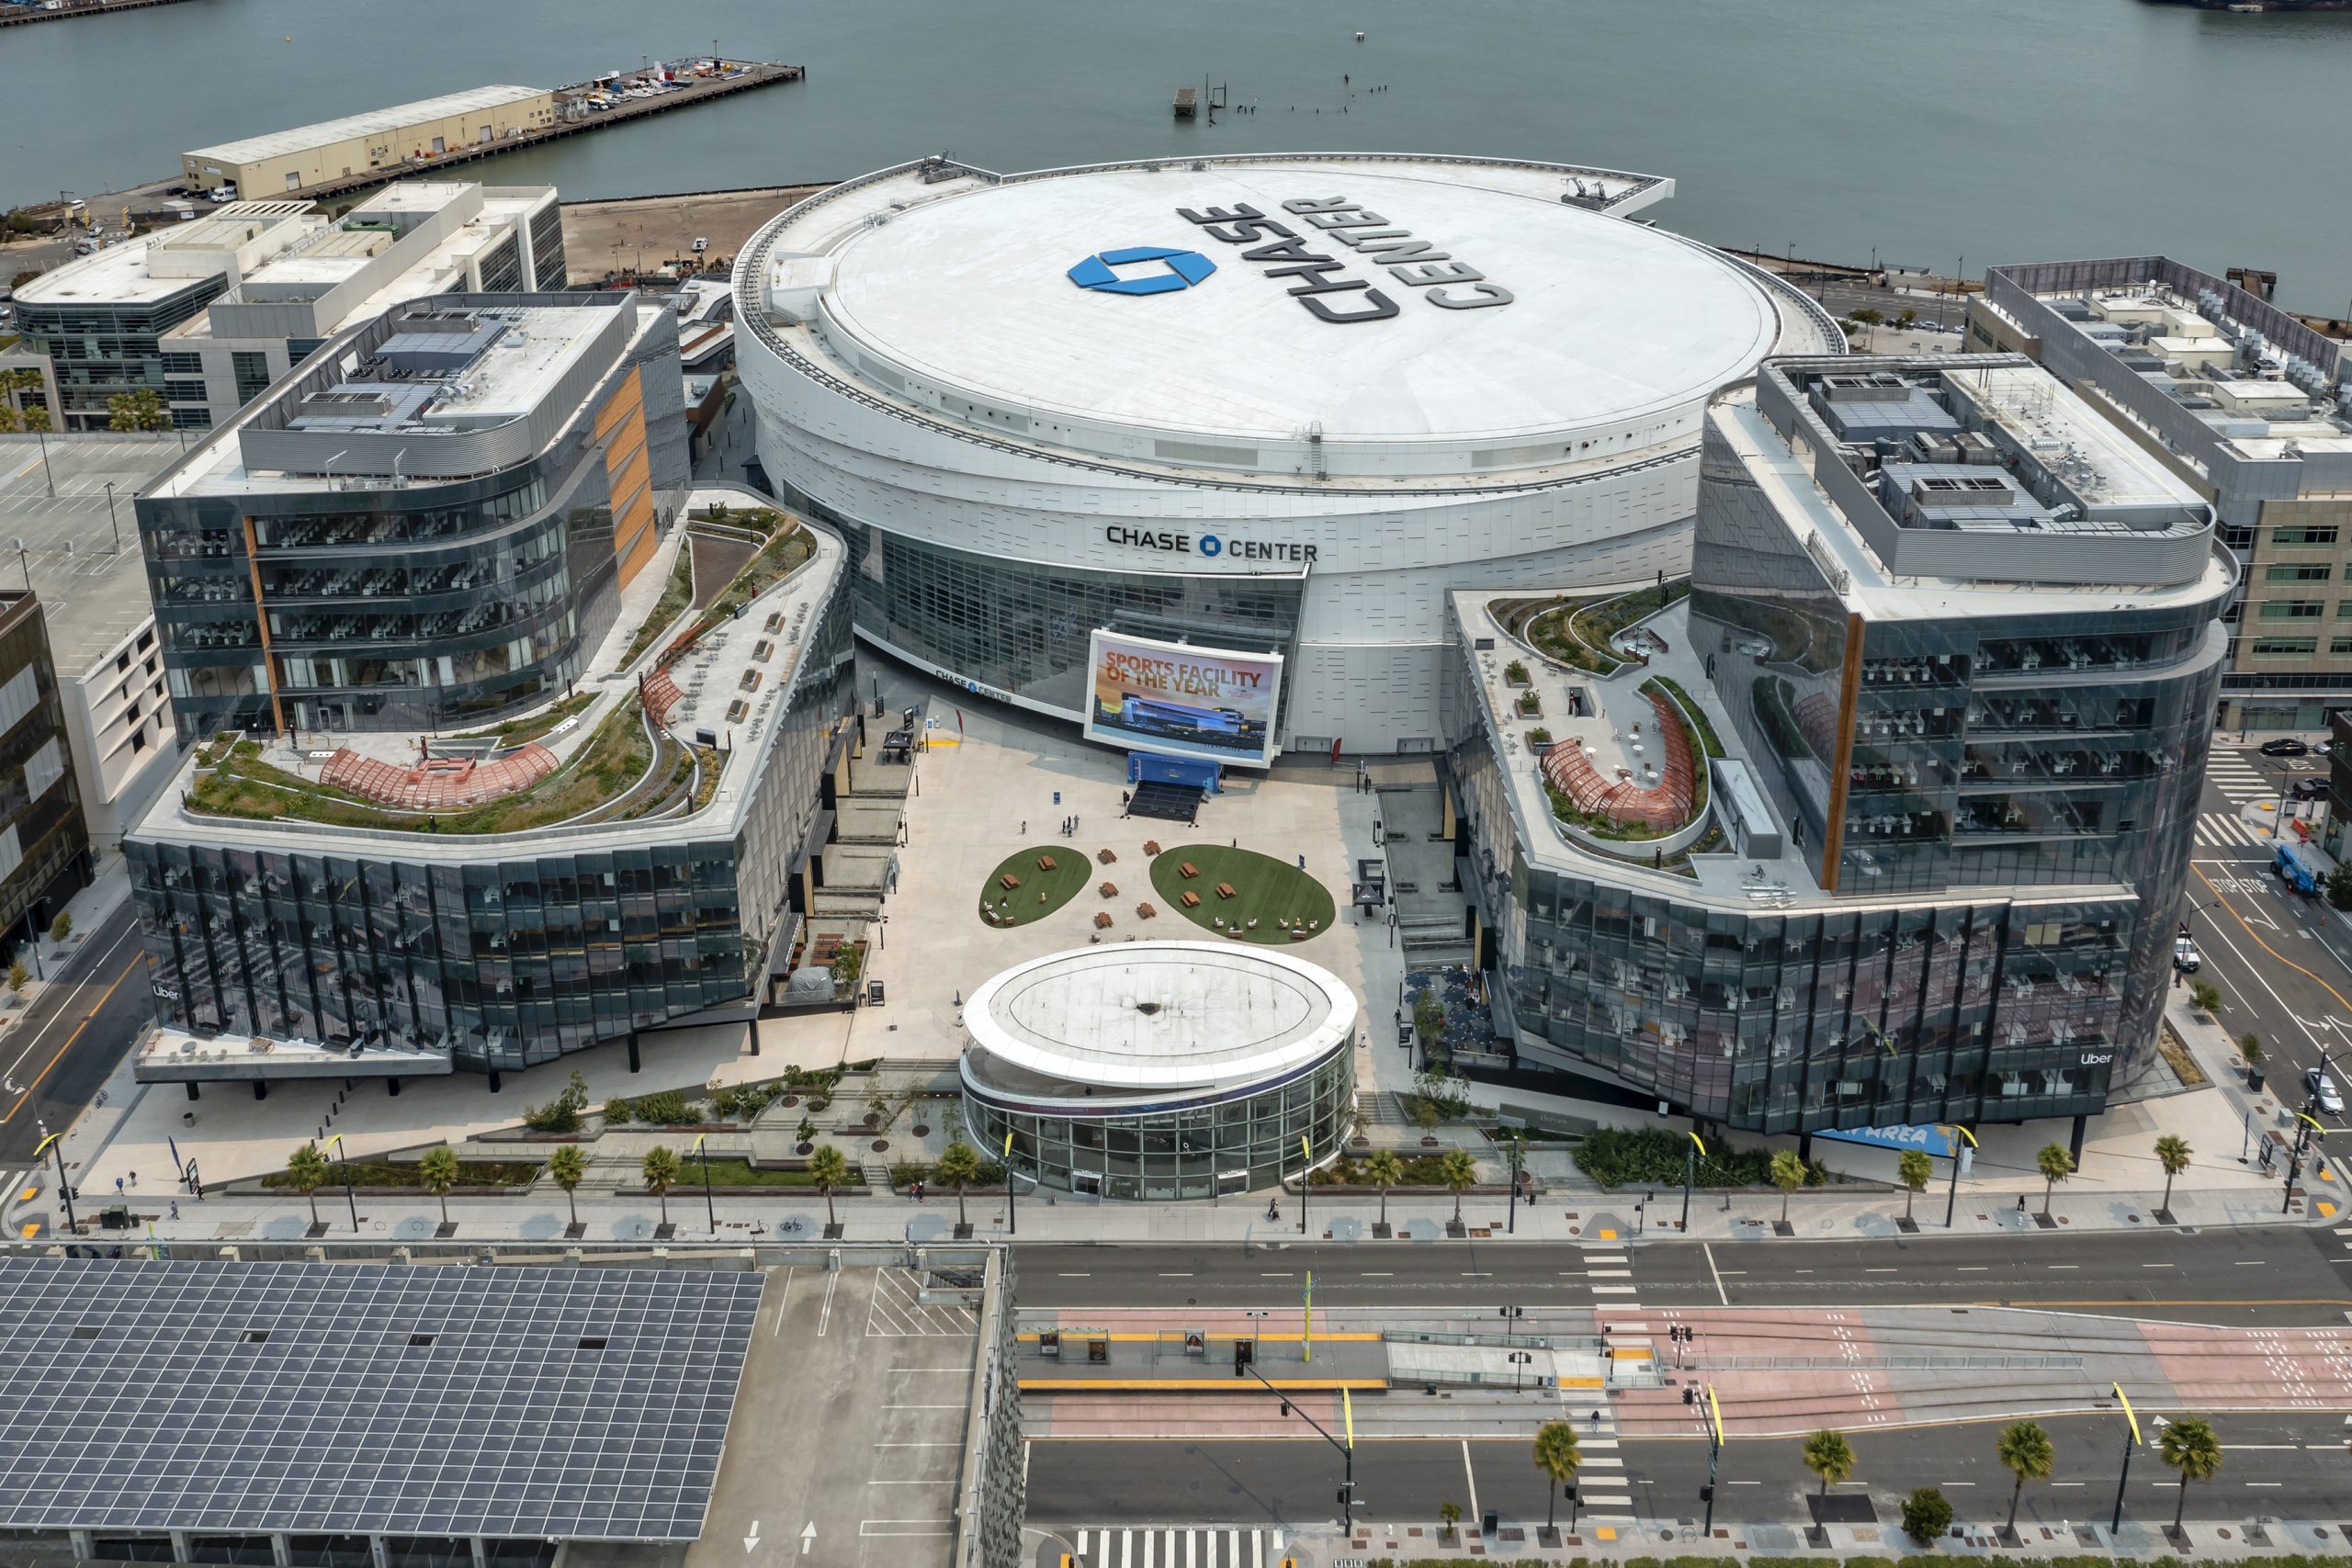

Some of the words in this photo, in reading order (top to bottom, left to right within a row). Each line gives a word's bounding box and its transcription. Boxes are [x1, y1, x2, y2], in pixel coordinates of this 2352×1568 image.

[1175, 202, 1400, 324] CHASE
[1282, 195, 1515, 310] CENTER
[1106, 525, 1191, 553] CHASE
[1229, 540, 1317, 562] CENTER
[1105, 650, 1175, 677] SPORTS
[1179, 663, 1262, 688] FACILITY
[1106, 666, 1129, 682] OF
[1132, 671, 1169, 690] THE
[1171, 677, 1221, 698] YEAR
[935, 670, 967, 687] CHASE
[978, 685, 1012, 704] CENTER
[2208, 878, 2239, 893] STOP
[2238, 878, 2269, 894] STOP
[153, 985, 179, 1000] Uber
[2081, 1053, 2112, 1065] Uber
[1865, 1125, 1928, 1145] AREA
